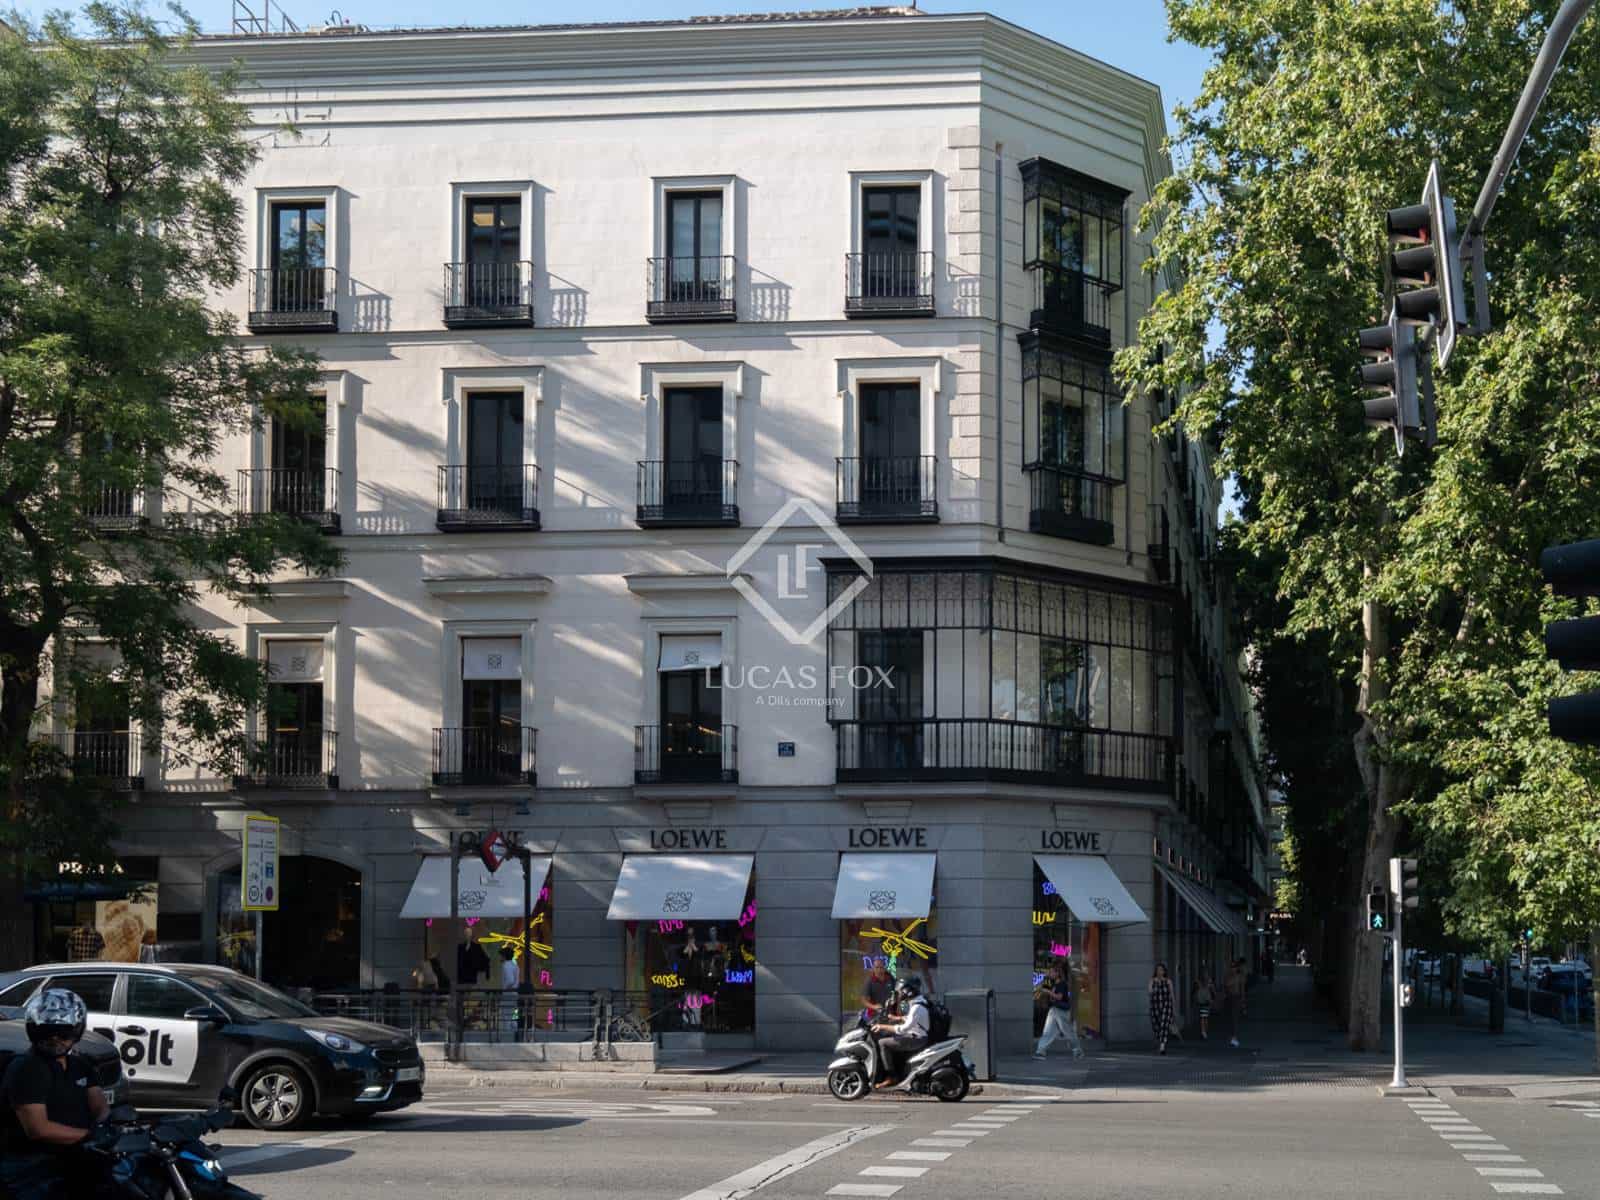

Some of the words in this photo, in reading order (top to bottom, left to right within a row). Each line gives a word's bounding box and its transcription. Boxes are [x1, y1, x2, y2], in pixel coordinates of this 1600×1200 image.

[650, 829, 728, 849] LOEWE
[848, 827, 927, 848] LOEWE
[1041, 830, 1101, 850] LOEWE
